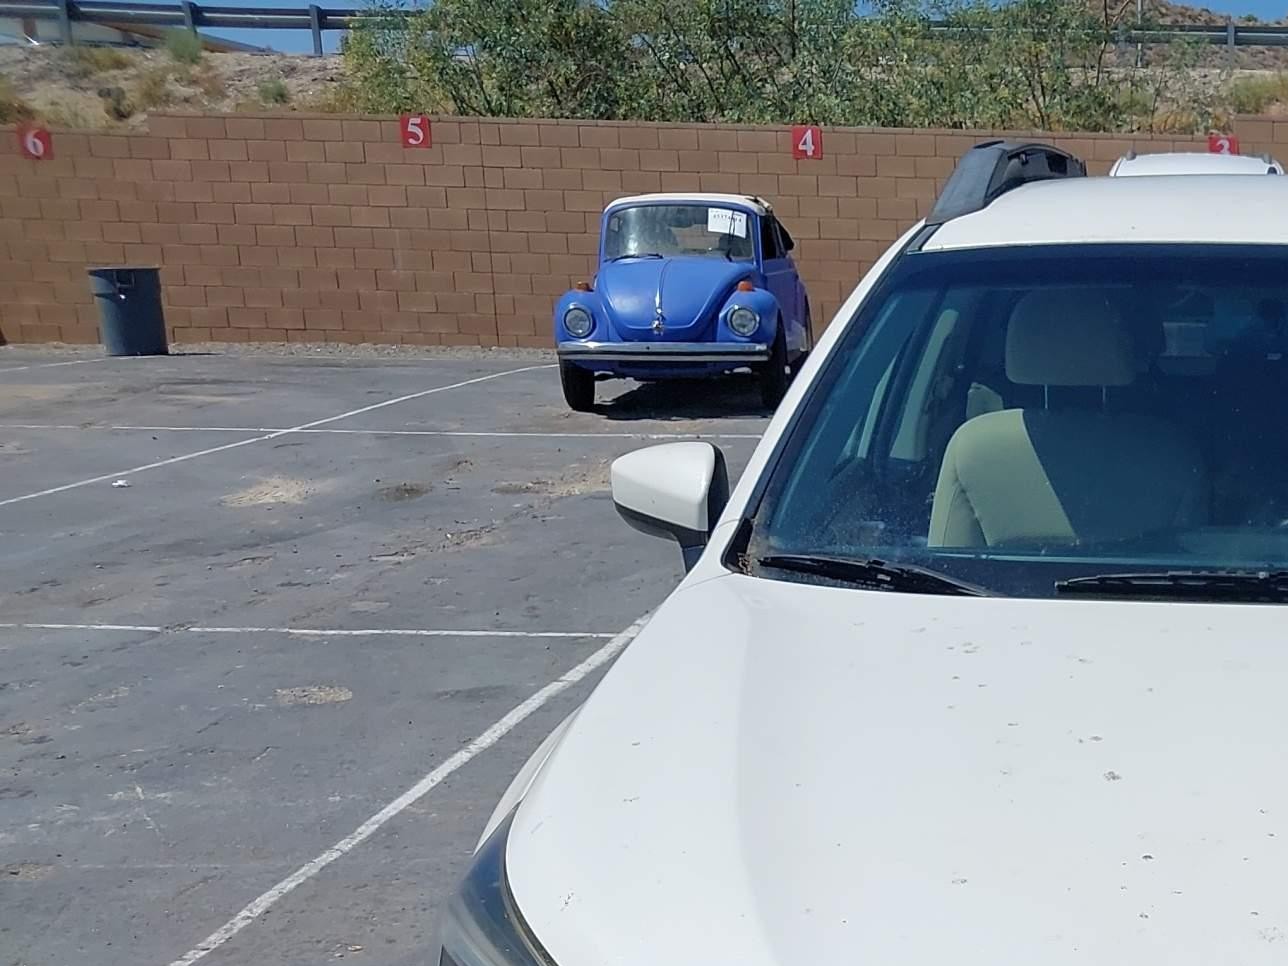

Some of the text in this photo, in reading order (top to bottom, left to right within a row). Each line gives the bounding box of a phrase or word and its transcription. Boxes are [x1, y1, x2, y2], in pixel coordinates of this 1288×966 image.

[25, 129, 44, 158] 6
[407, 117, 424, 145] 5
[798, 129, 815, 156] 4
